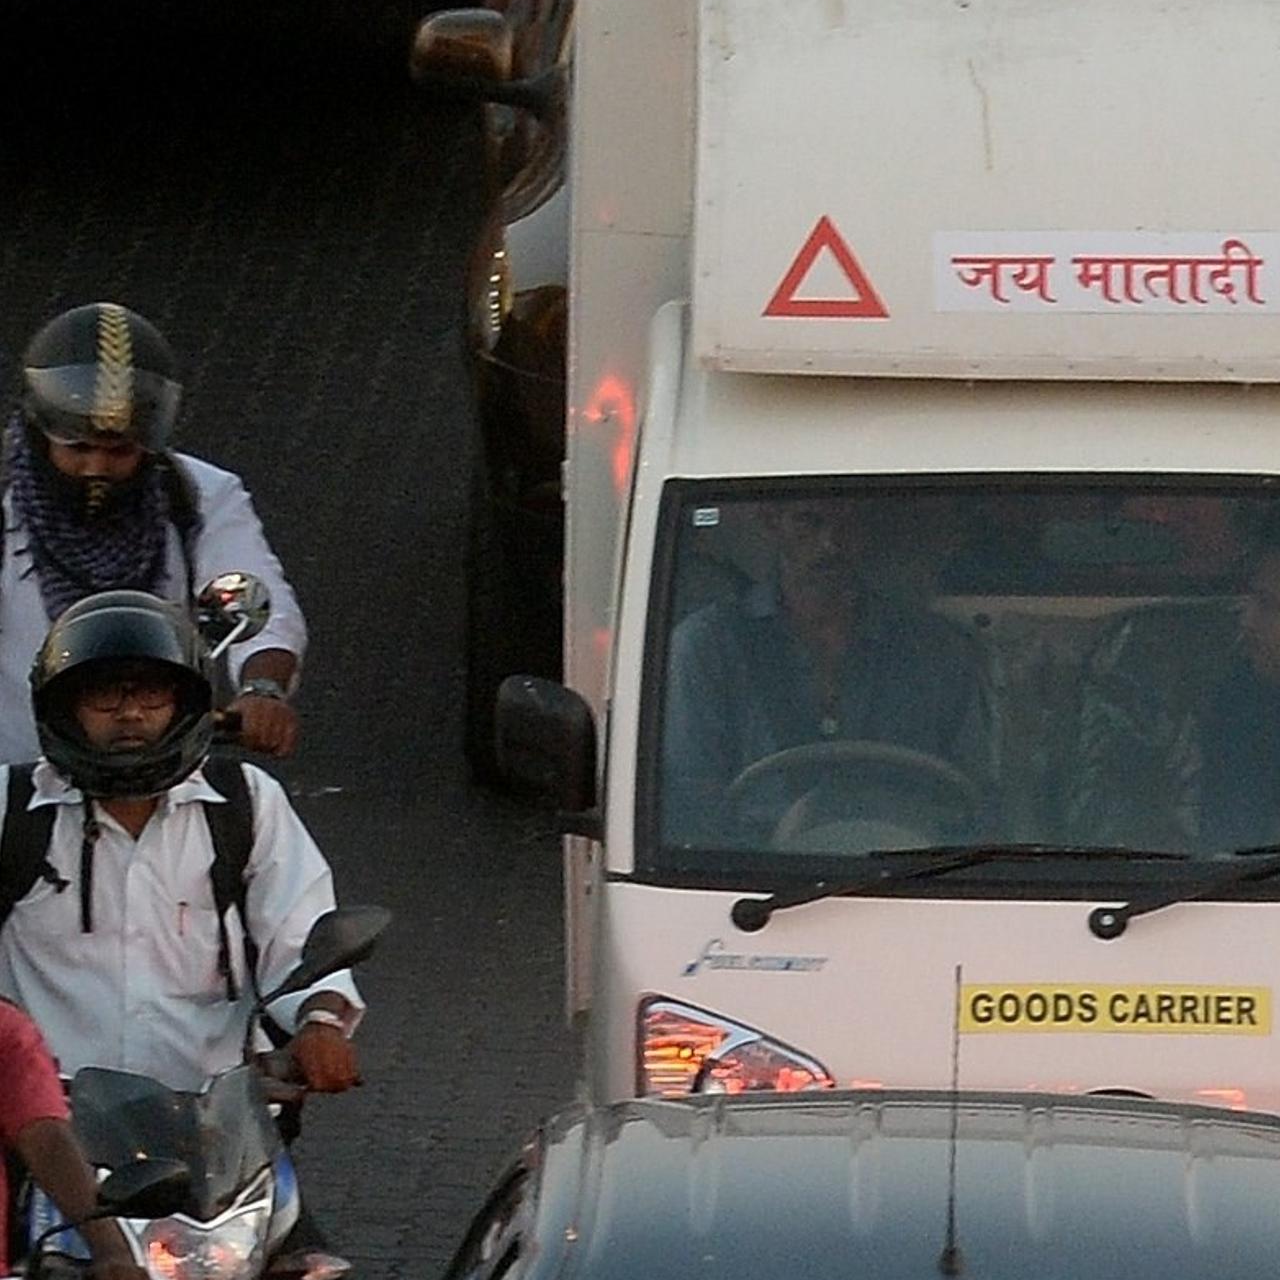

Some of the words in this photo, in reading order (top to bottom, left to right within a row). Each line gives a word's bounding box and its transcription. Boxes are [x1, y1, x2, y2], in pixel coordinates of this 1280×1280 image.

[951, 256, 1057, 303] जय
[1071, 238, 1266, 304] मातादी
[970, 992, 1098, 1024] GOODS
[1108, 992, 1258, 1025] CARRIER
